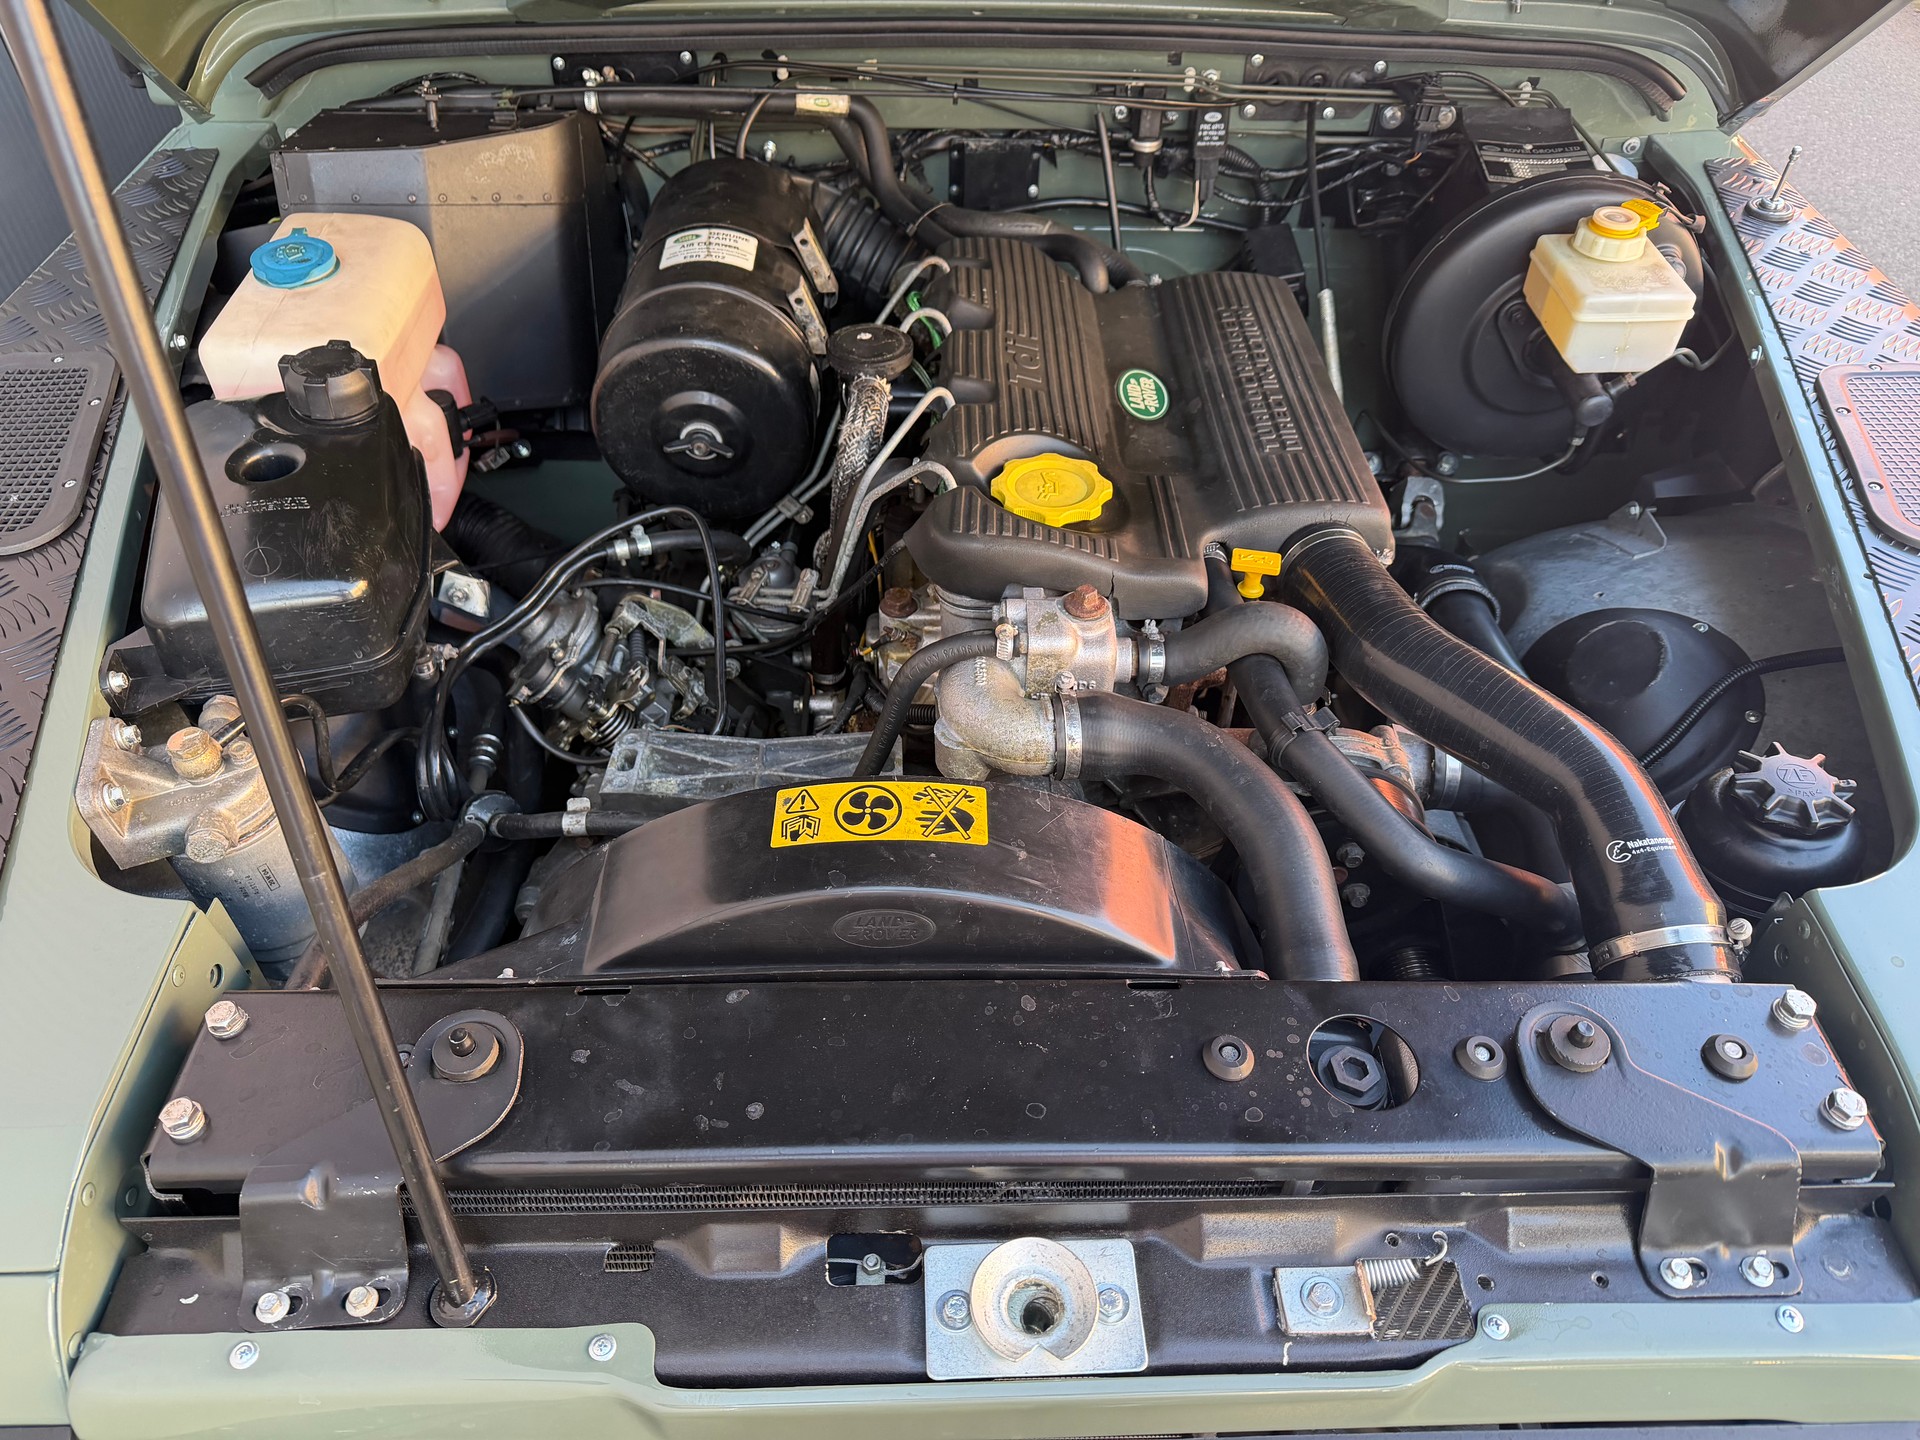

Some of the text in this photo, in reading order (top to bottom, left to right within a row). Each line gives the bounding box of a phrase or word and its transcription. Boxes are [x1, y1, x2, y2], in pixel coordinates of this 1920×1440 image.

[1531, 147, 1564, 155] GROUP
[697, 241, 740, 251] CLEANER
[1126, 383, 1146, 410] LAND
[1139, 376, 1160, 408] ROVER
